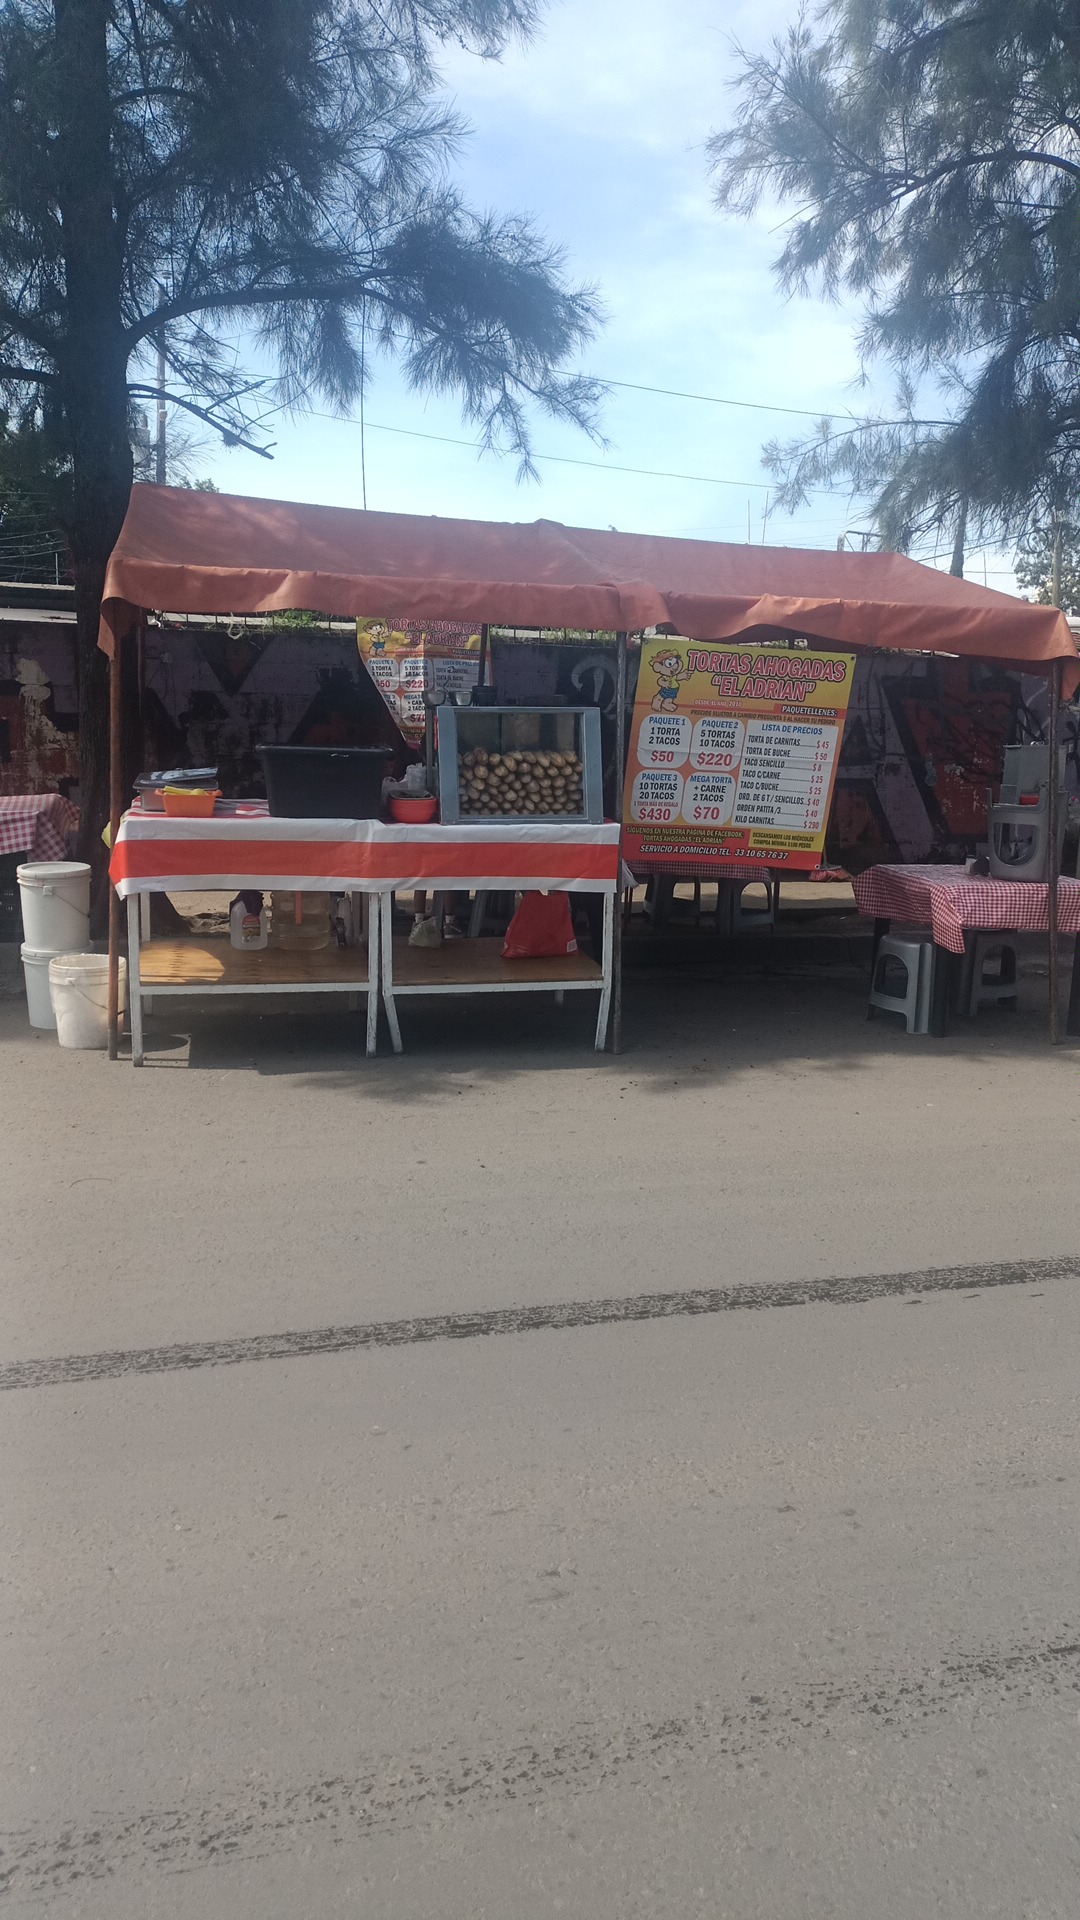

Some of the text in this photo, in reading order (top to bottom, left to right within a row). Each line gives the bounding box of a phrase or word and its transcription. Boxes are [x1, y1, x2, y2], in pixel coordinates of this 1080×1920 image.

[387, 619, 482, 634] TORTAS AHOGADAS
[687, 650, 846, 682] TORTAS AHOGADAS
[405, 680, 429, 688] $220
[649, 717, 680, 725] PAQUETE
[757, 713, 782, 721] PREGUNTA
[702, 720, 733, 729] PAQUETE
[651, 727, 680, 735] 1 TORTA
[762, 724, 823, 735] LISTA DE PRECIOS
[700, 730, 735, 739] 5 TORTAS
[655, 737, 680, 745] TACOS
[700, 739, 735, 748] 10 TACOS
[748, 735, 764, 743] TORTA
[774, 738, 800, 747] CARNITAS
[821, 741, 829, 749] 45
[651, 750, 675, 762] $50
[746, 747, 762, 755] TORTA
[764, 748, 771, 756] DE
[772, 749, 791, 757] BUCHE
[820, 753, 828, 761] 50
[697, 751, 733, 767] $220
[744, 758, 757, 766] TACO
[758, 759, 785, 769] SENCILLO
[642, 773, 672, 781] PAQUETE
[690, 775, 732, 784] MEGA TORTA
[742, 770, 756, 778] TACO
[757, 770, 781, 780] C/CARNE
[639, 782, 678, 791] 10 TORTAS
[700, 784, 727, 793] CARNE
[740, 781, 754, 790] TACO
[814, 787, 822, 795] 25
[639, 791, 675, 800] 20 TACOS
[693, 793, 724, 802] 2 TACOS
[738, 793, 752, 801] ORD.
[775, 796, 804, 805] SENCILLOS
[638, 807, 671, 820] $430
[693, 805, 720, 820] $70
[737, 804, 755, 812] ORDEN
[756, 805, 773, 813] PATITA
[810, 810, 818, 818] 40
[748, 816, 774, 825] CARNITAS
[752, 832, 783, 840] DESCANSAMOS
[640, 844, 673, 853] SERVICIO
[679, 846, 718, 854] DOMICILIO
[718, 848, 731, 856] TEL.
[735, 848, 745, 856] 33
[746, 849, 756, 857] 10
[756, 850, 766, 858] 65
[767, 851, 777, 859] 76
[777, 852, 789, 860] 37
